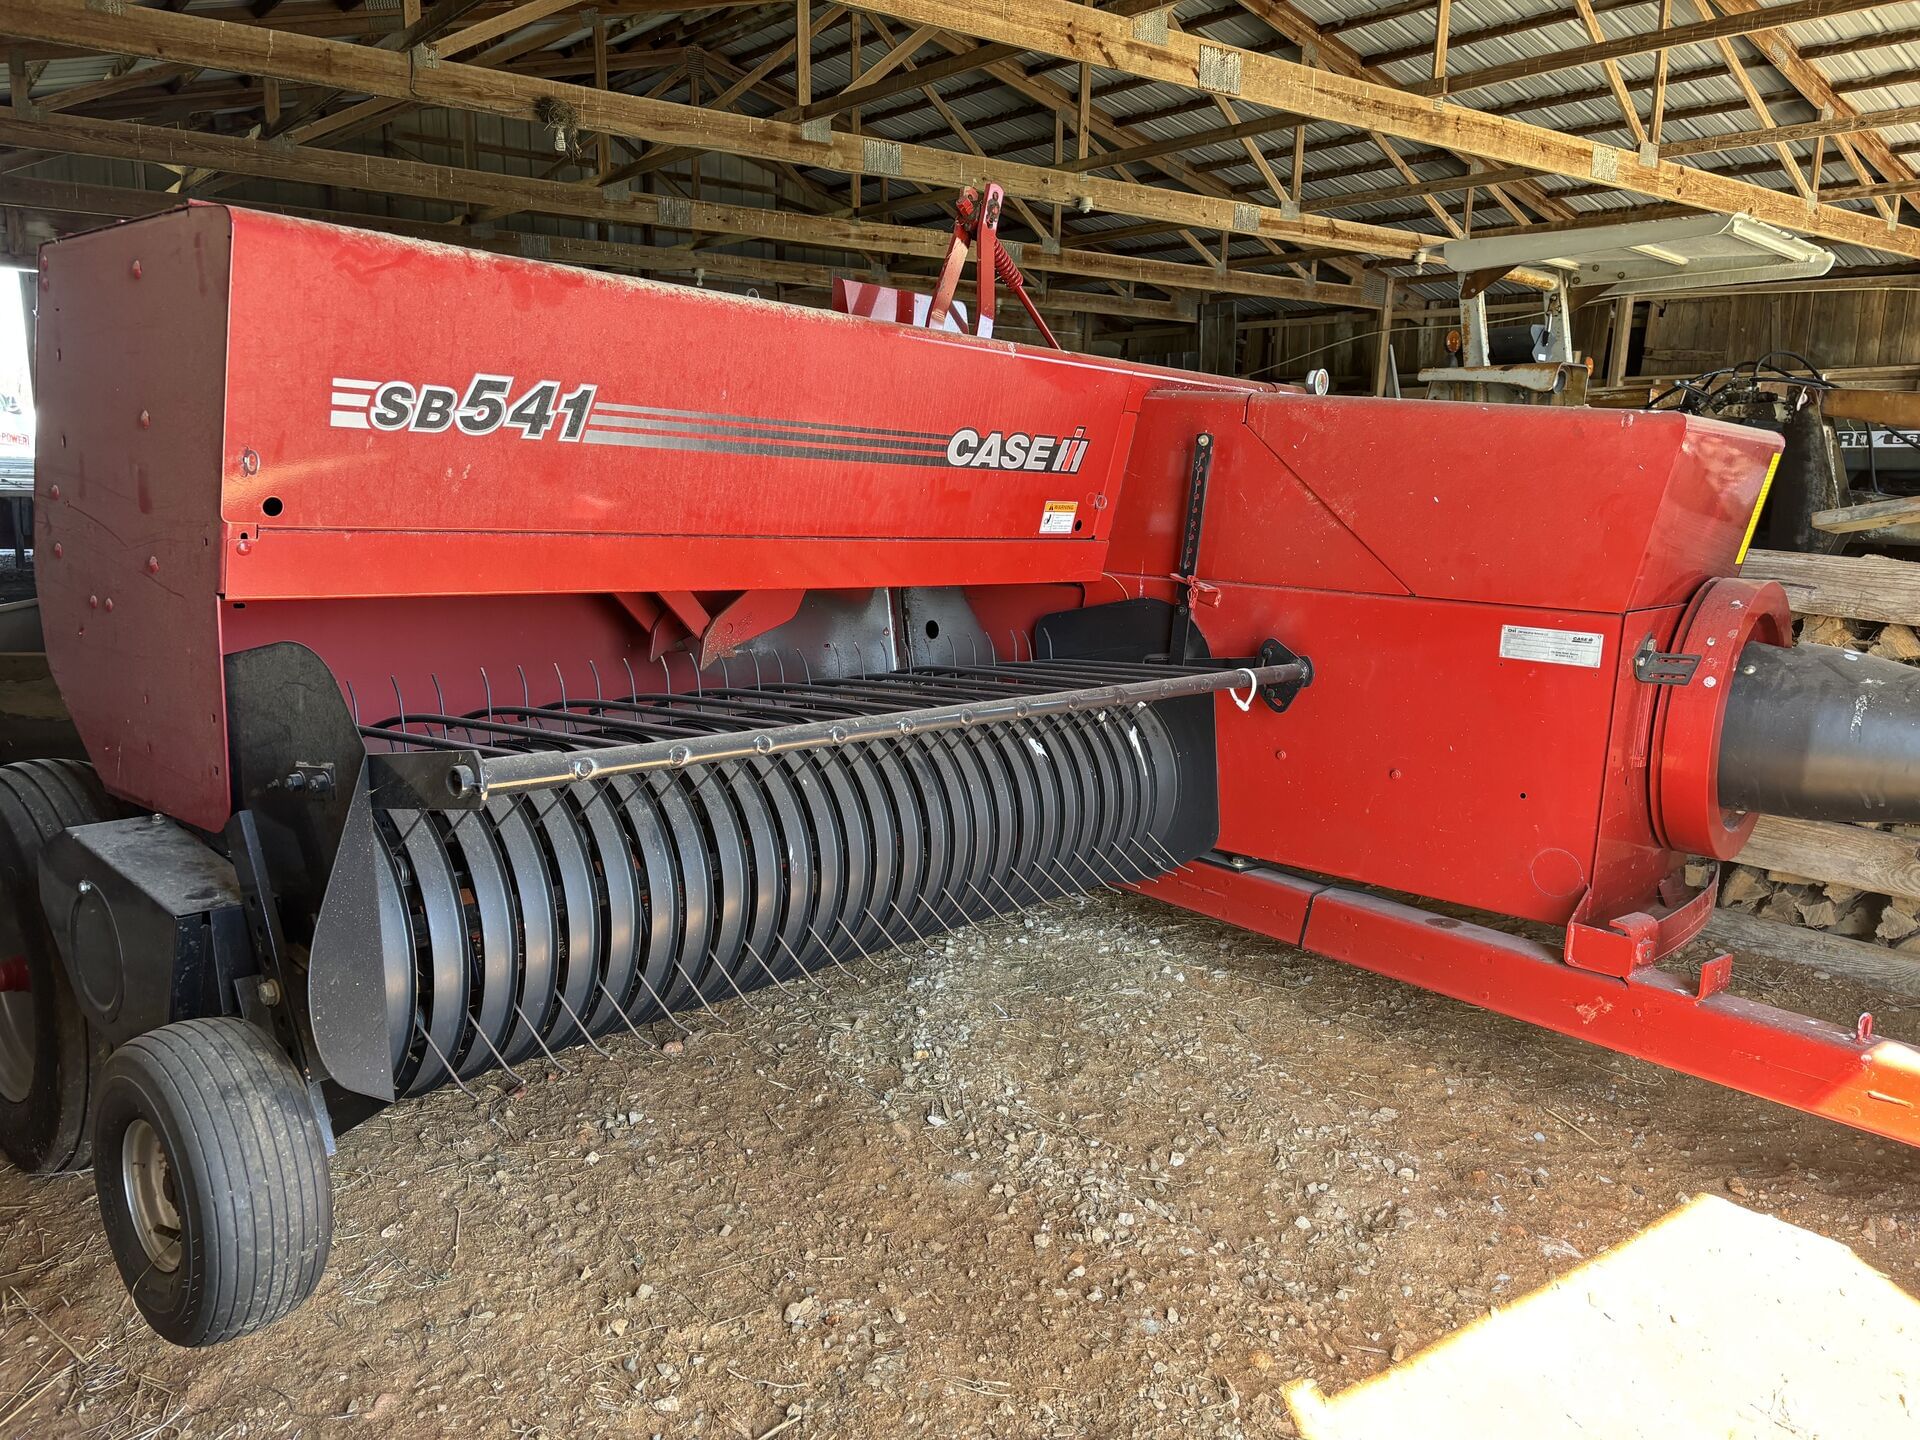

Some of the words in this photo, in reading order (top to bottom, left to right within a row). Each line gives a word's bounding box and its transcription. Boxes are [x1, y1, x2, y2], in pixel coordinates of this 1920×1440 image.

[369, 372, 598, 443] SB541
[1, 432, 28, 446] POWER
[947, 428, 1056, 470] CASE
